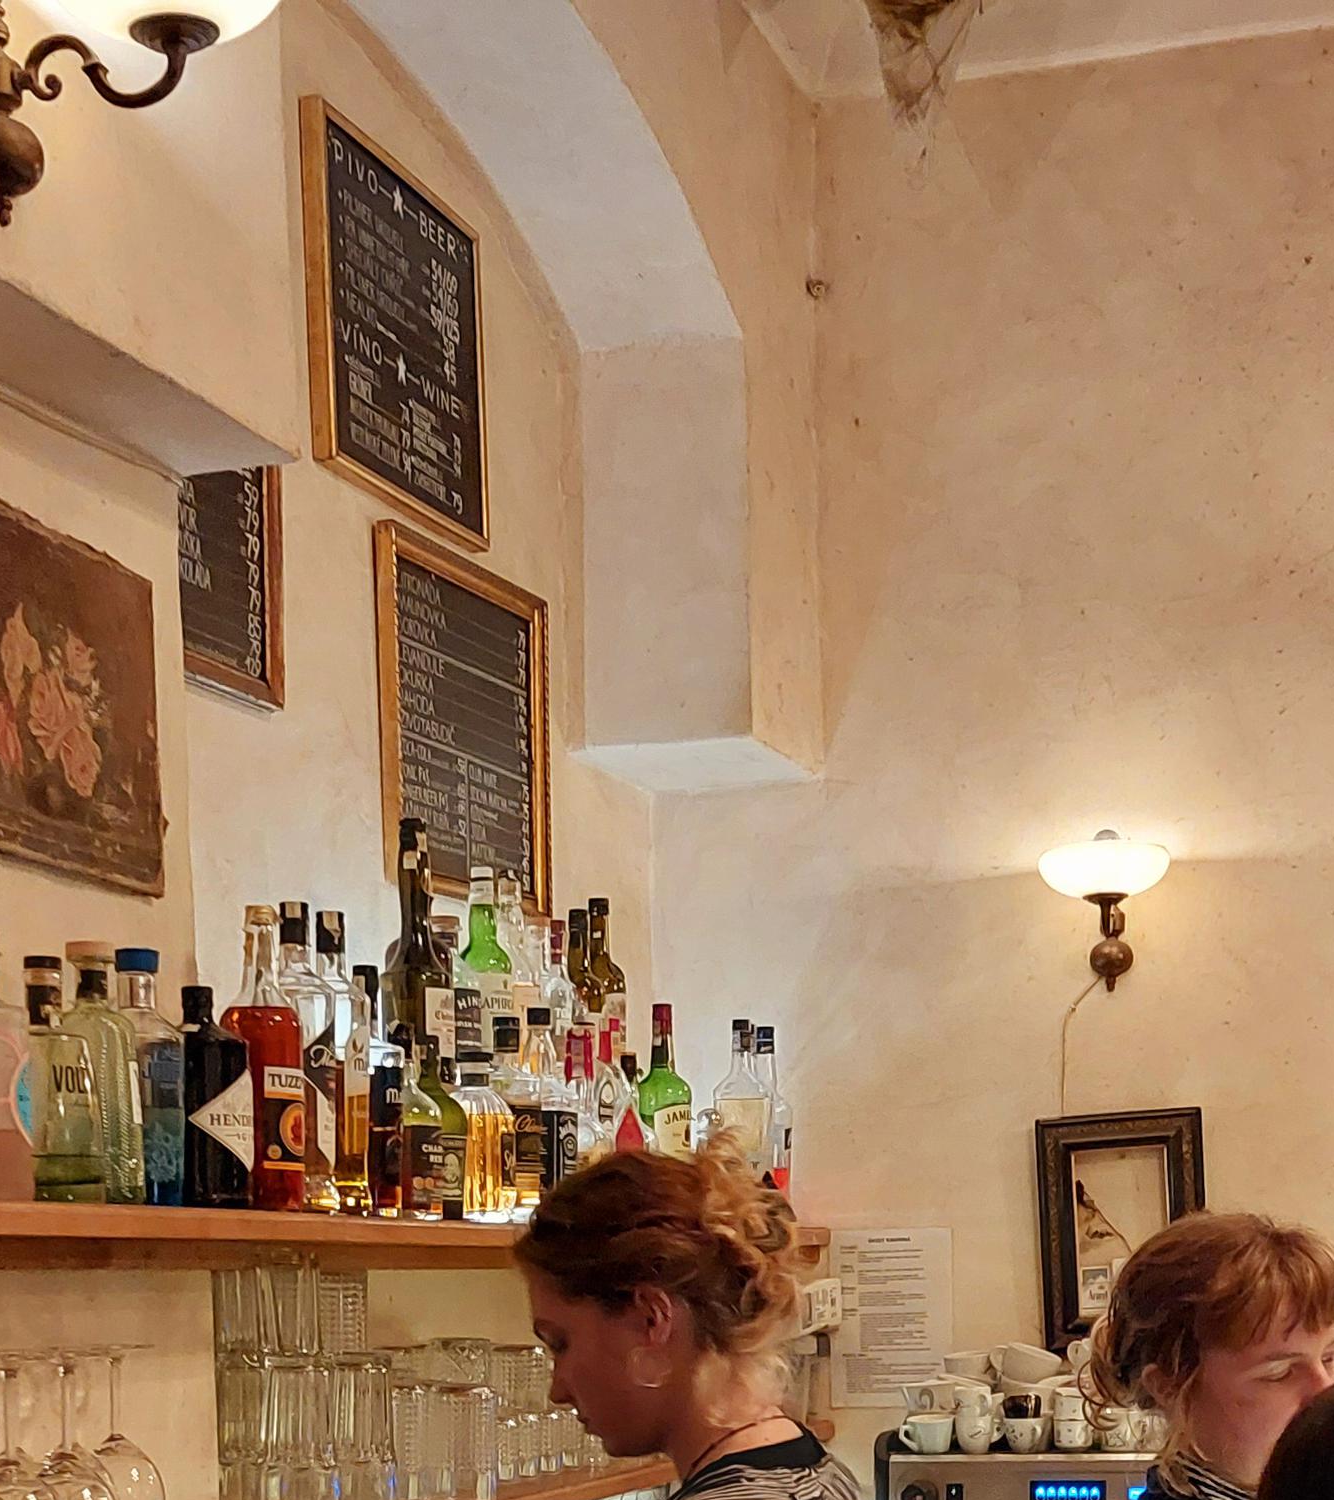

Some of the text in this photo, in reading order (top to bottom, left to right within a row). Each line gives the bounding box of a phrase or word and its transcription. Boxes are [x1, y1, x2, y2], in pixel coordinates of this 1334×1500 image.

[331, 137, 378, 195] PIVO
[419, 210, 458, 263] BEER
[340, 318, 383, 365] VÍNO
[421, 375, 461, 419] WINE
[243, 481, 259, 509] 59
[244, 507, 260, 534] 79
[244, 532, 260, 563] 79
[246, 559, 260, 587] 79
[247, 585, 262, 613] 79
